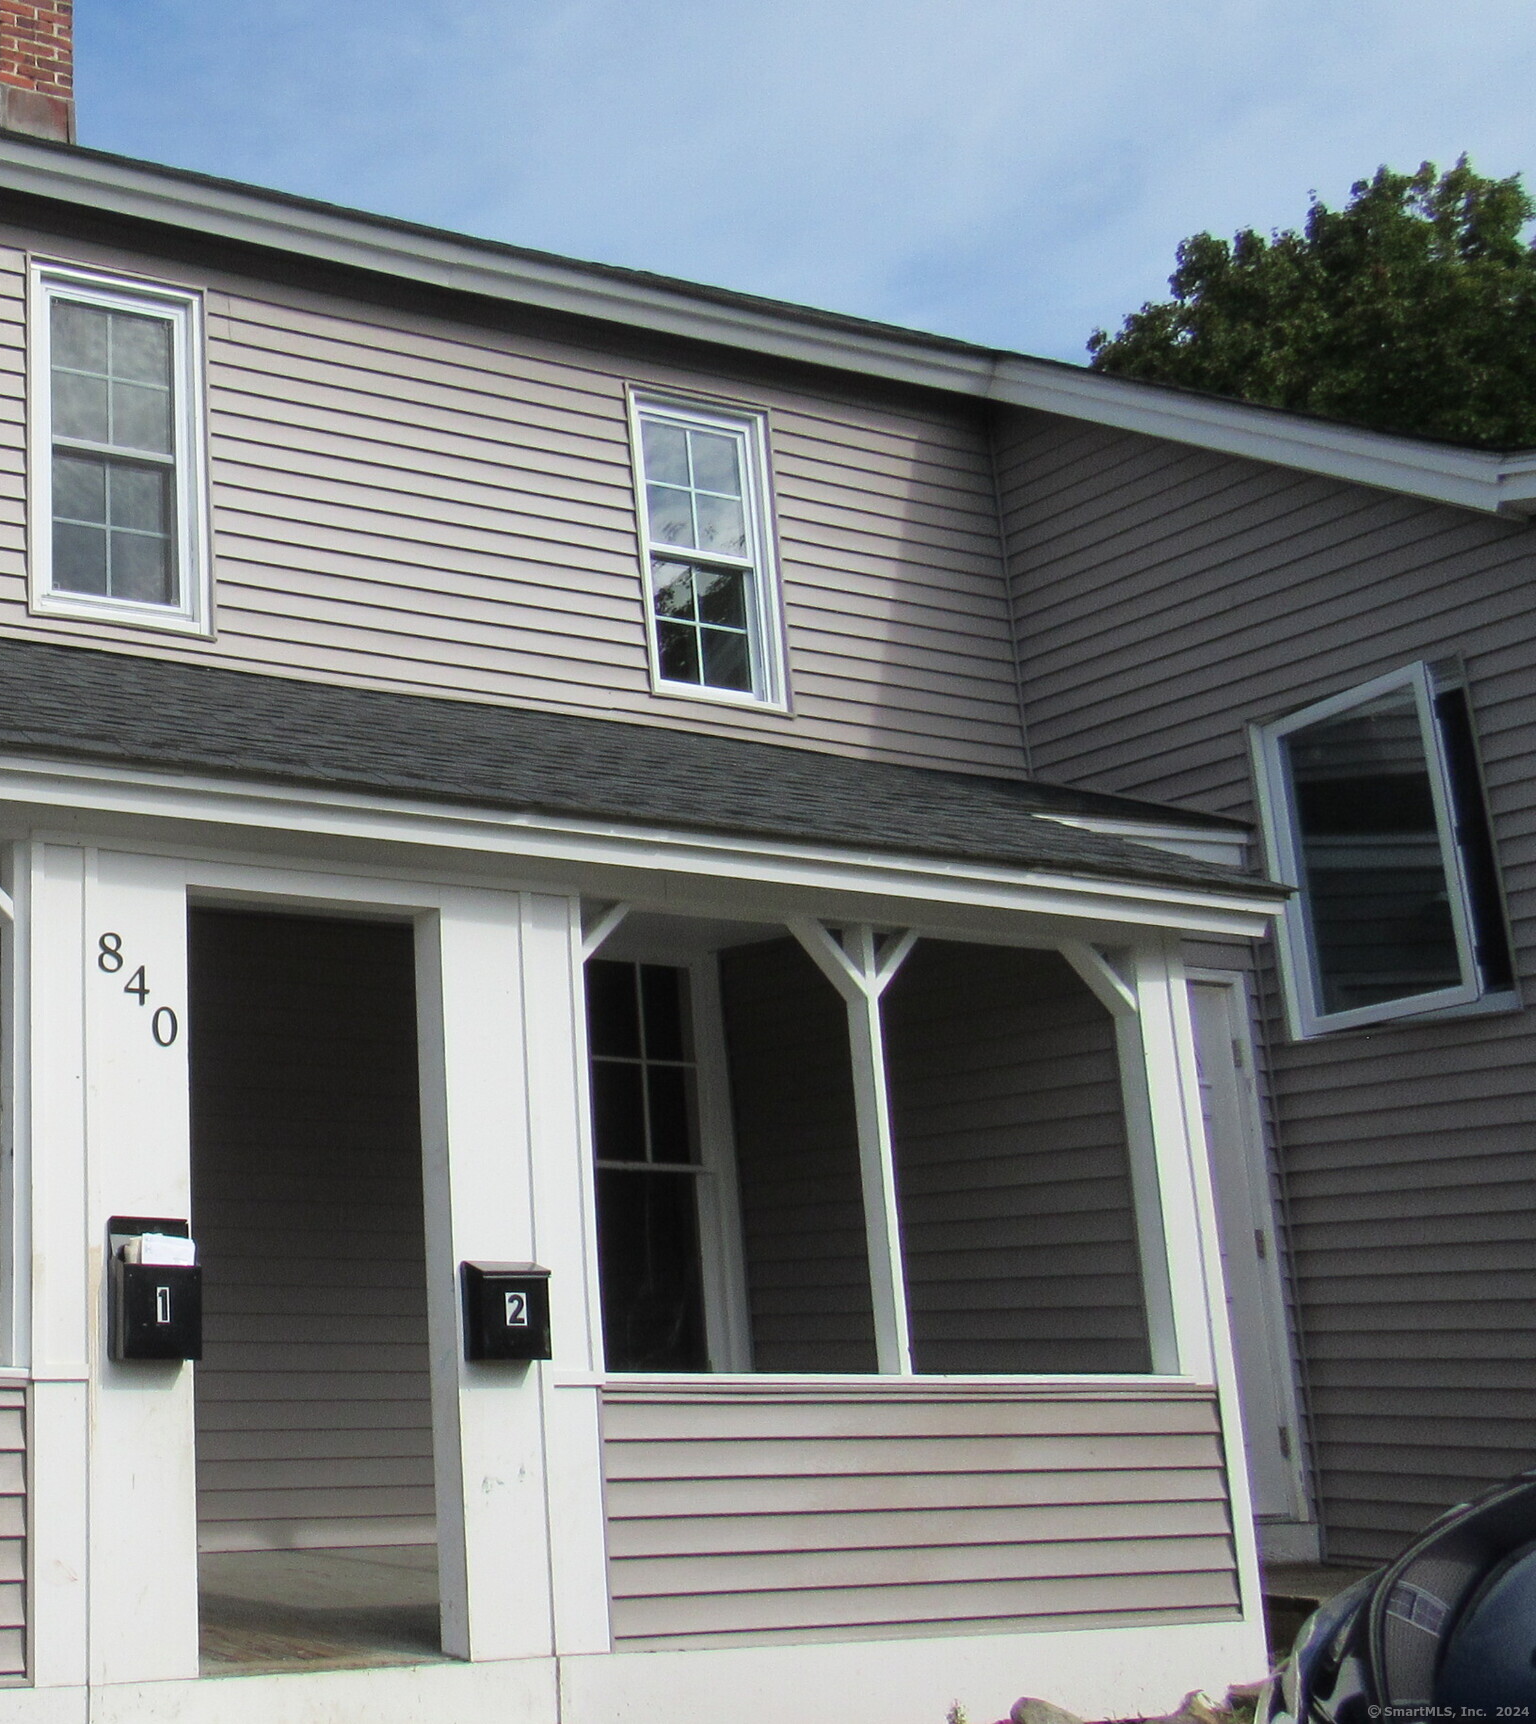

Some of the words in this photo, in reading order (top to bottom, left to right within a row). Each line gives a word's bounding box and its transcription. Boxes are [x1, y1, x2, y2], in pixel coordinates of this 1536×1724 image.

[97, 931, 178, 1047] 840
[157, 1288, 168, 1321] 1
[507, 1293, 525, 1324] 2
